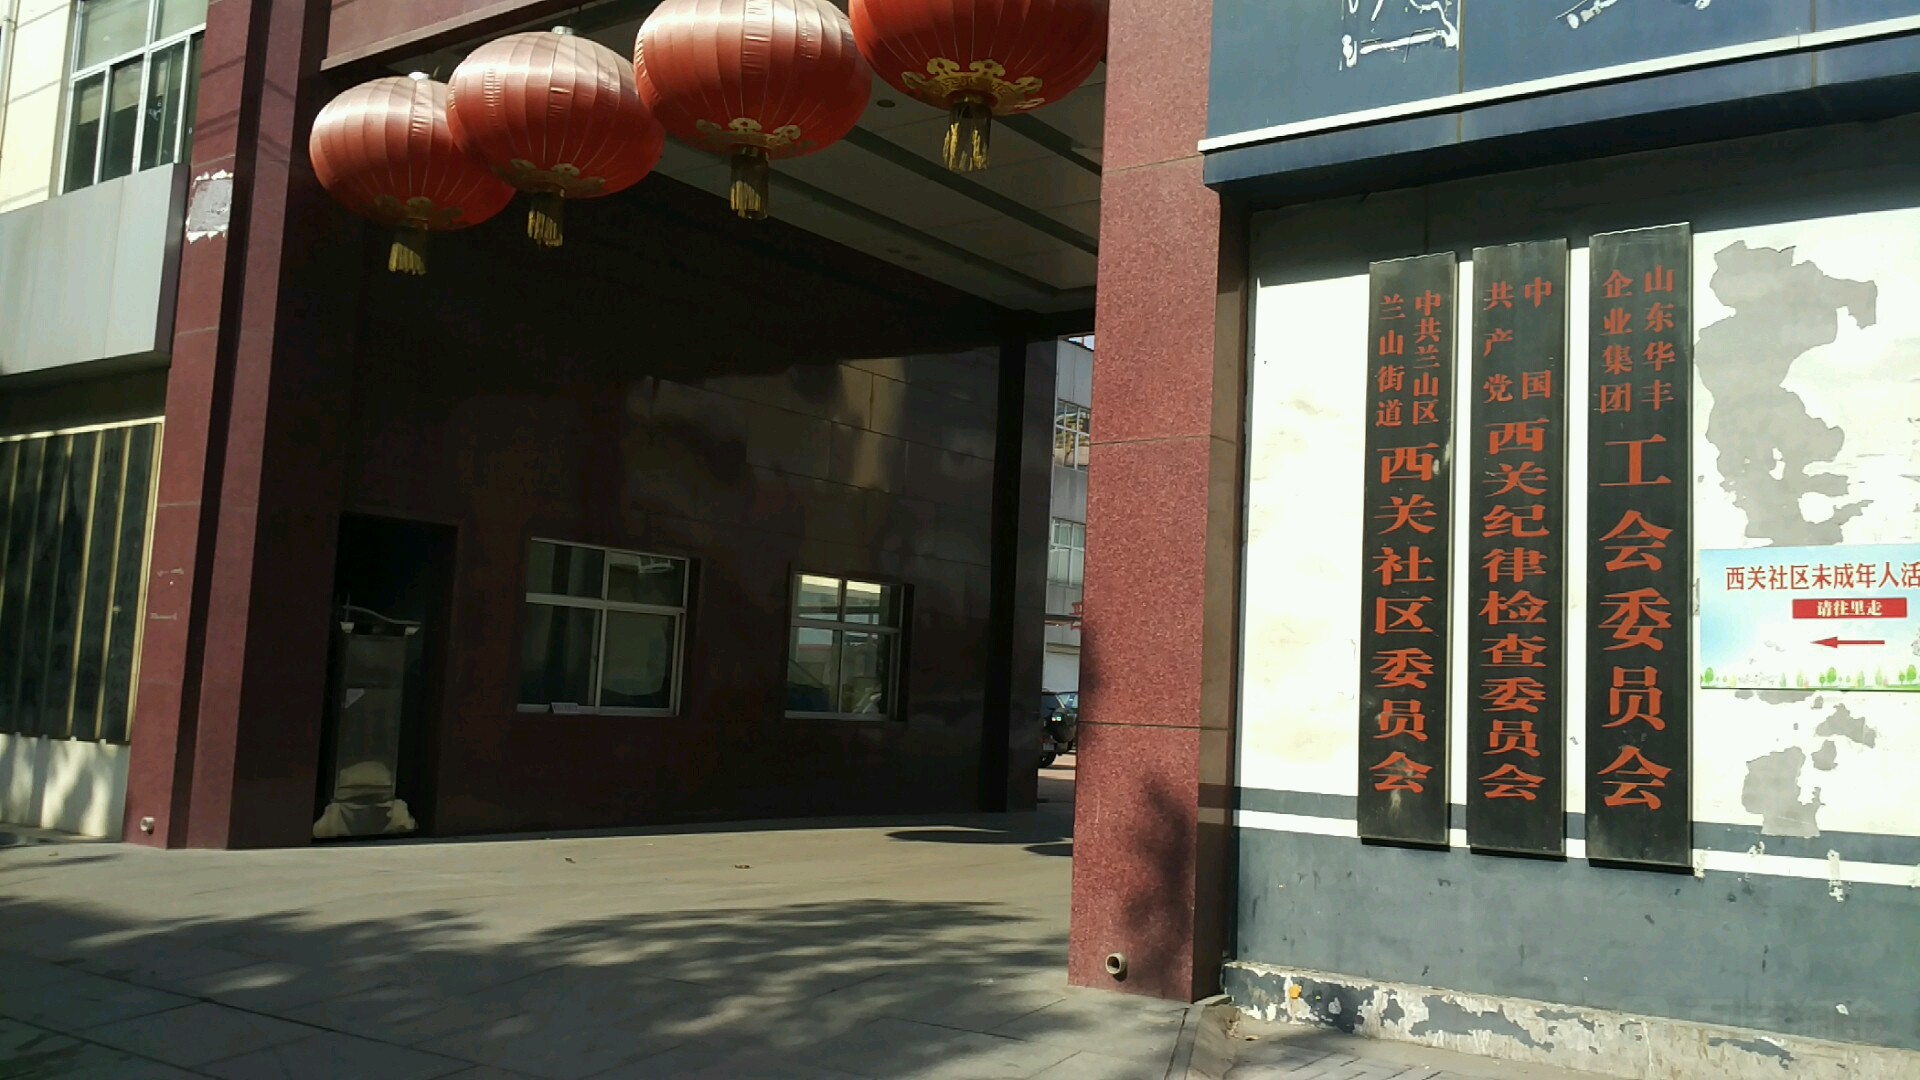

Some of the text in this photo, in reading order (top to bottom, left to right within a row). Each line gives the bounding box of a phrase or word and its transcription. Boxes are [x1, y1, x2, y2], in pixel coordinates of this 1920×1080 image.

[1376, 295, 1405, 428] 兰山街道
[1412, 290, 1441, 425] 中共兰山区
[1483, 281, 1513, 403] 共产党
[1599, 270, 1633, 414] 企业集团
[1641, 264, 1675, 410] 山东华丰
[1370, 443, 1439, 794] 西关社区委员会
[1479, 418, 1549, 801] 西关纪律检查委员会
[1597, 434, 1673, 811] 工会委员会
[1726, 561, 1920, 591] 西关社区未成年人活
[1816, 600, 1882, 617] 请往里走
